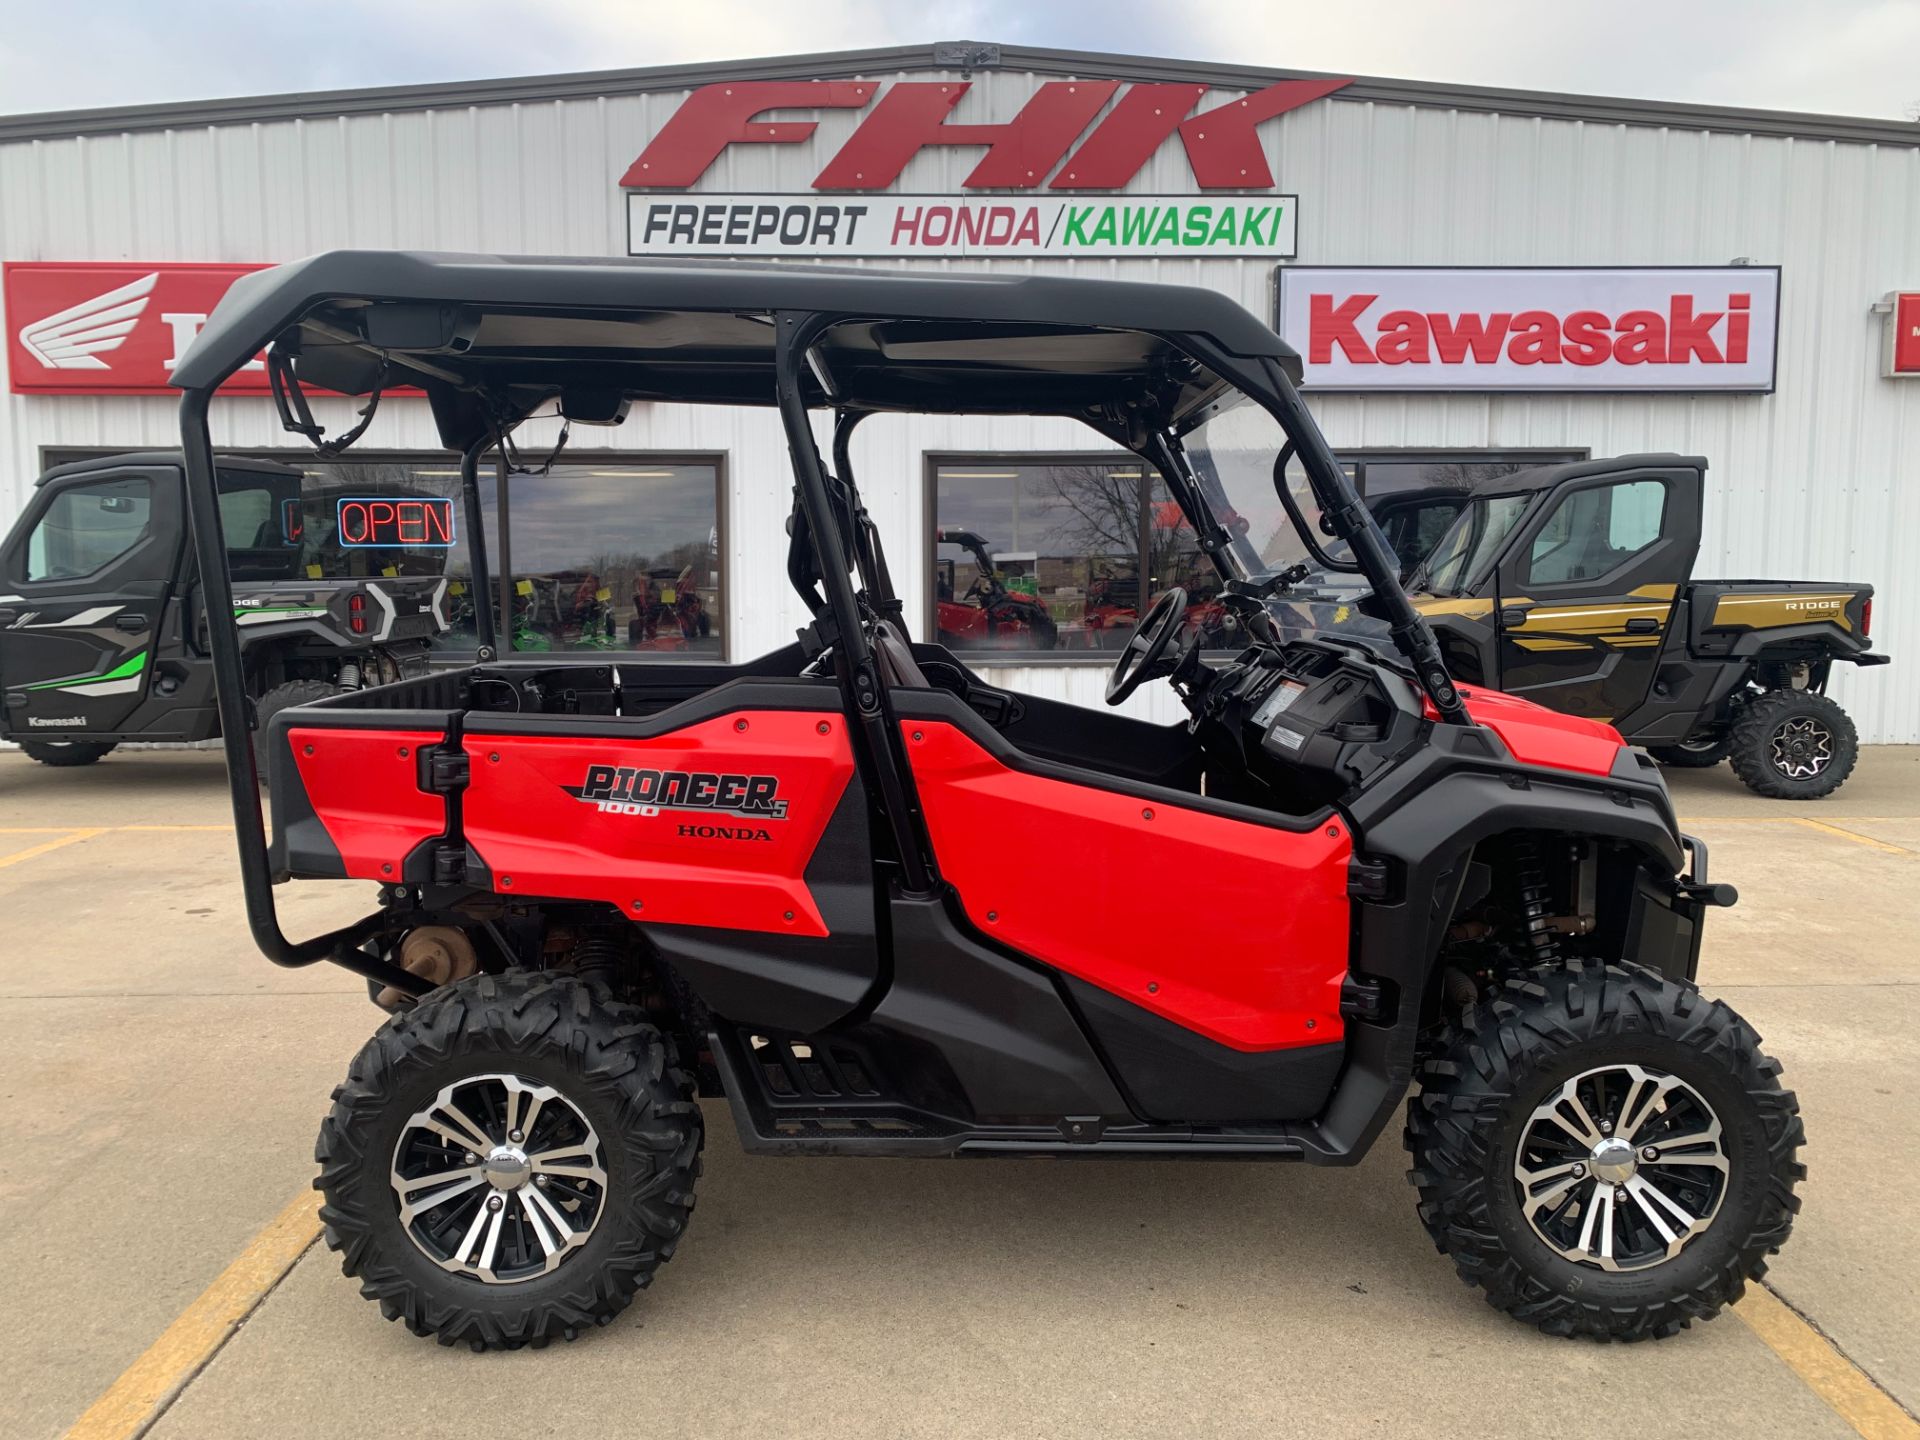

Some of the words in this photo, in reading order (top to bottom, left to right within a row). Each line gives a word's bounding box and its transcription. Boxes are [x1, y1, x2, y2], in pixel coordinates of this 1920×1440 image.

[619, 79, 1356, 189] FHK
[643, 204, 868, 246] FREEPORT
[1308, 293, 1751, 366] Kawasaki
[341, 502, 451, 543] OPEN
[1785, 600, 1841, 610] RIDGE
[27, 716, 87, 727] Kawasaki
[582, 764, 779, 810] PIONEER
[597, 801, 660, 817] 1000
[677, 824, 774, 842] HONDA
